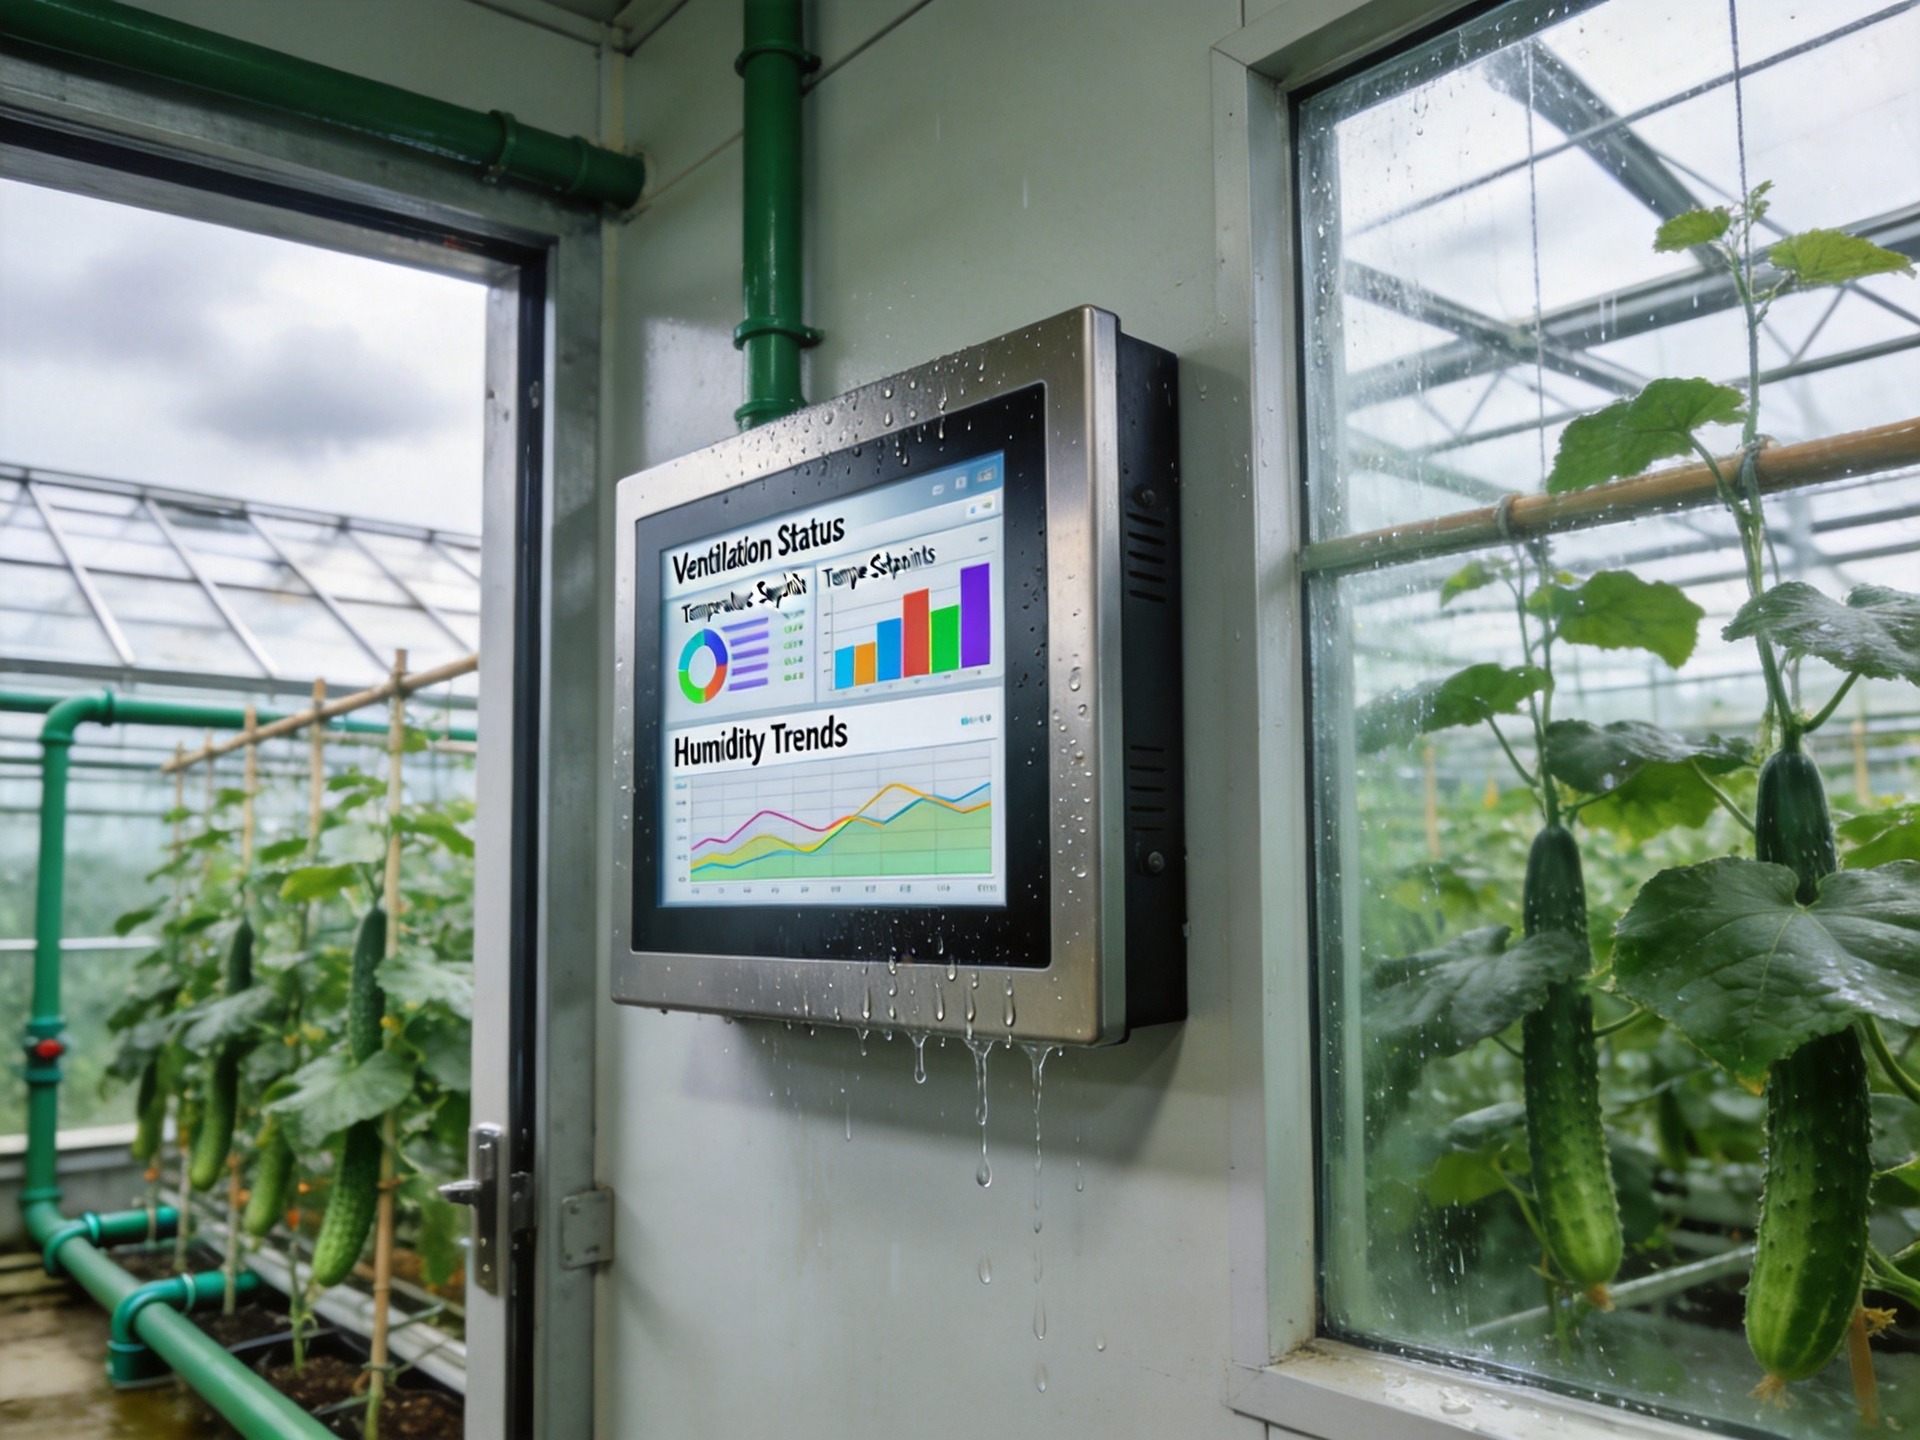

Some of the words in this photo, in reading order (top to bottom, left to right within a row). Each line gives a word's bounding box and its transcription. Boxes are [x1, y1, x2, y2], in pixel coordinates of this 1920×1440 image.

[672, 536, 772, 584] Ventilation
[777, 517, 846, 556] Status
[674, 726, 766, 767] Humidity
[770, 714, 848, 754] Trends
